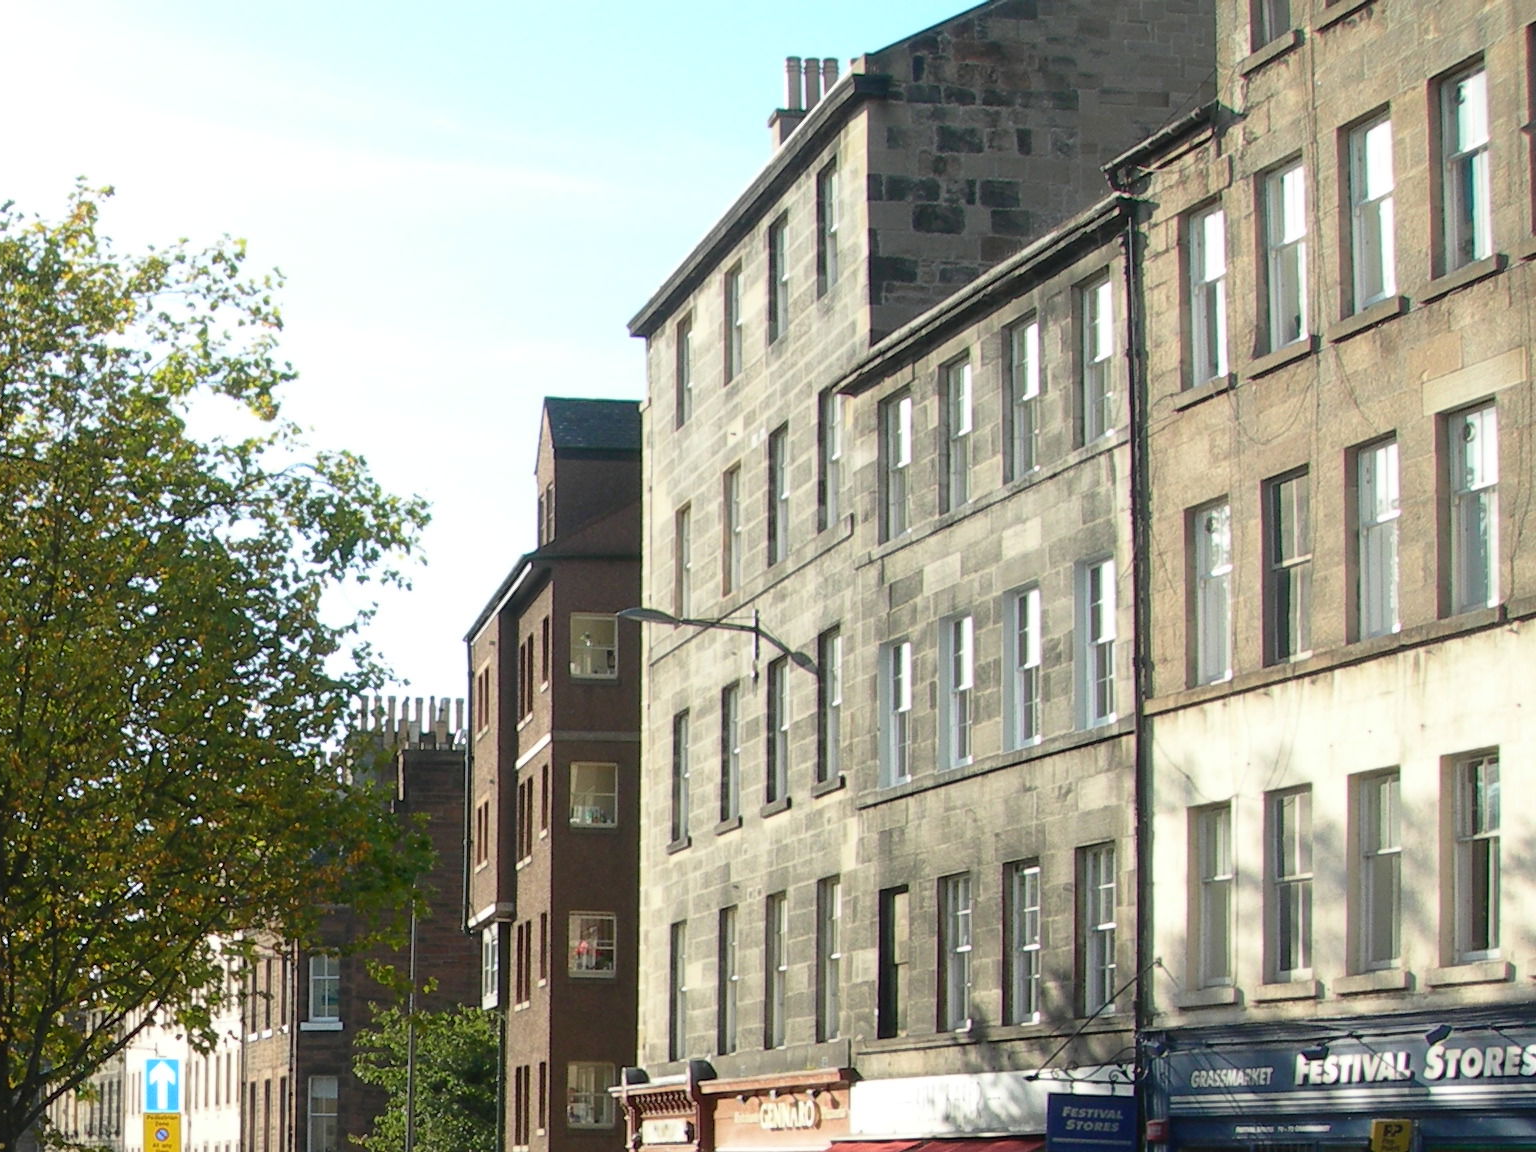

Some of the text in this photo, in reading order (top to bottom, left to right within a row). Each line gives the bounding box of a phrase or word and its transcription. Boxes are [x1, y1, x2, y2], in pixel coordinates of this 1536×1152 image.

[1191, 1044, 1536, 1088] GRASSMARKET FESTIVAL STORES
[760, 1100, 816, 1129] GENNARO
[1061, 1106, 1124, 1120] FESTIVAL
[1064, 1118, 1120, 1132] STORES
